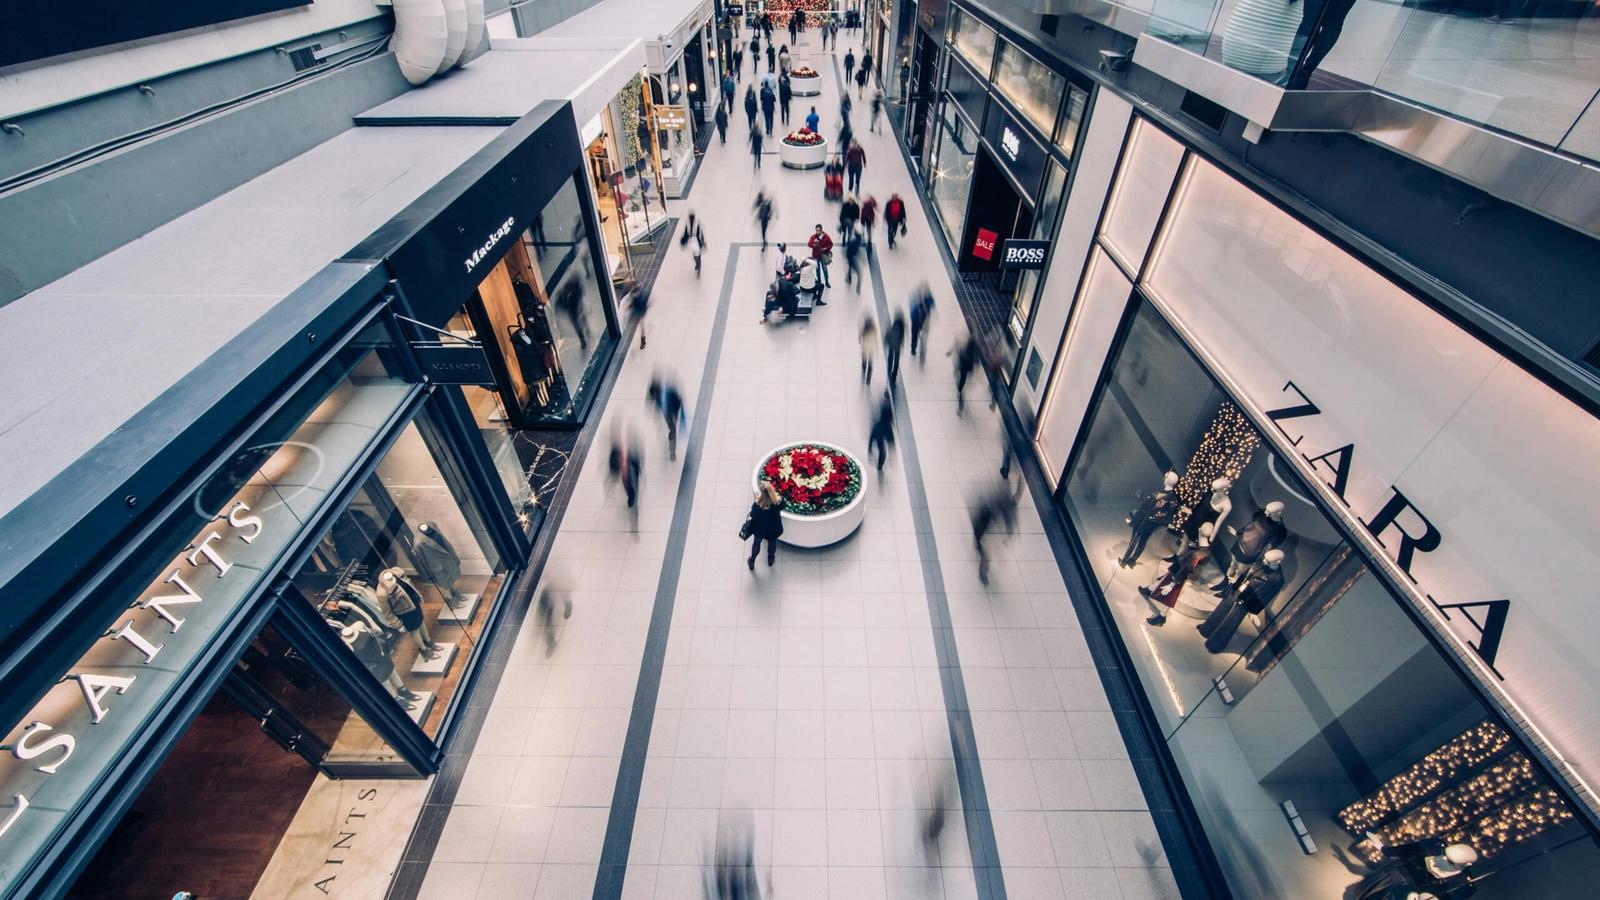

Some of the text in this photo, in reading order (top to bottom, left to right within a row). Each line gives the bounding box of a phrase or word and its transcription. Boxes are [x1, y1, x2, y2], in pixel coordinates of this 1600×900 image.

[464, 216, 514, 273] Mackage
[975, 238, 995, 251] SALE
[1006, 247, 1045, 259] BOSS
[1265, 380, 1511, 682] ZARA
